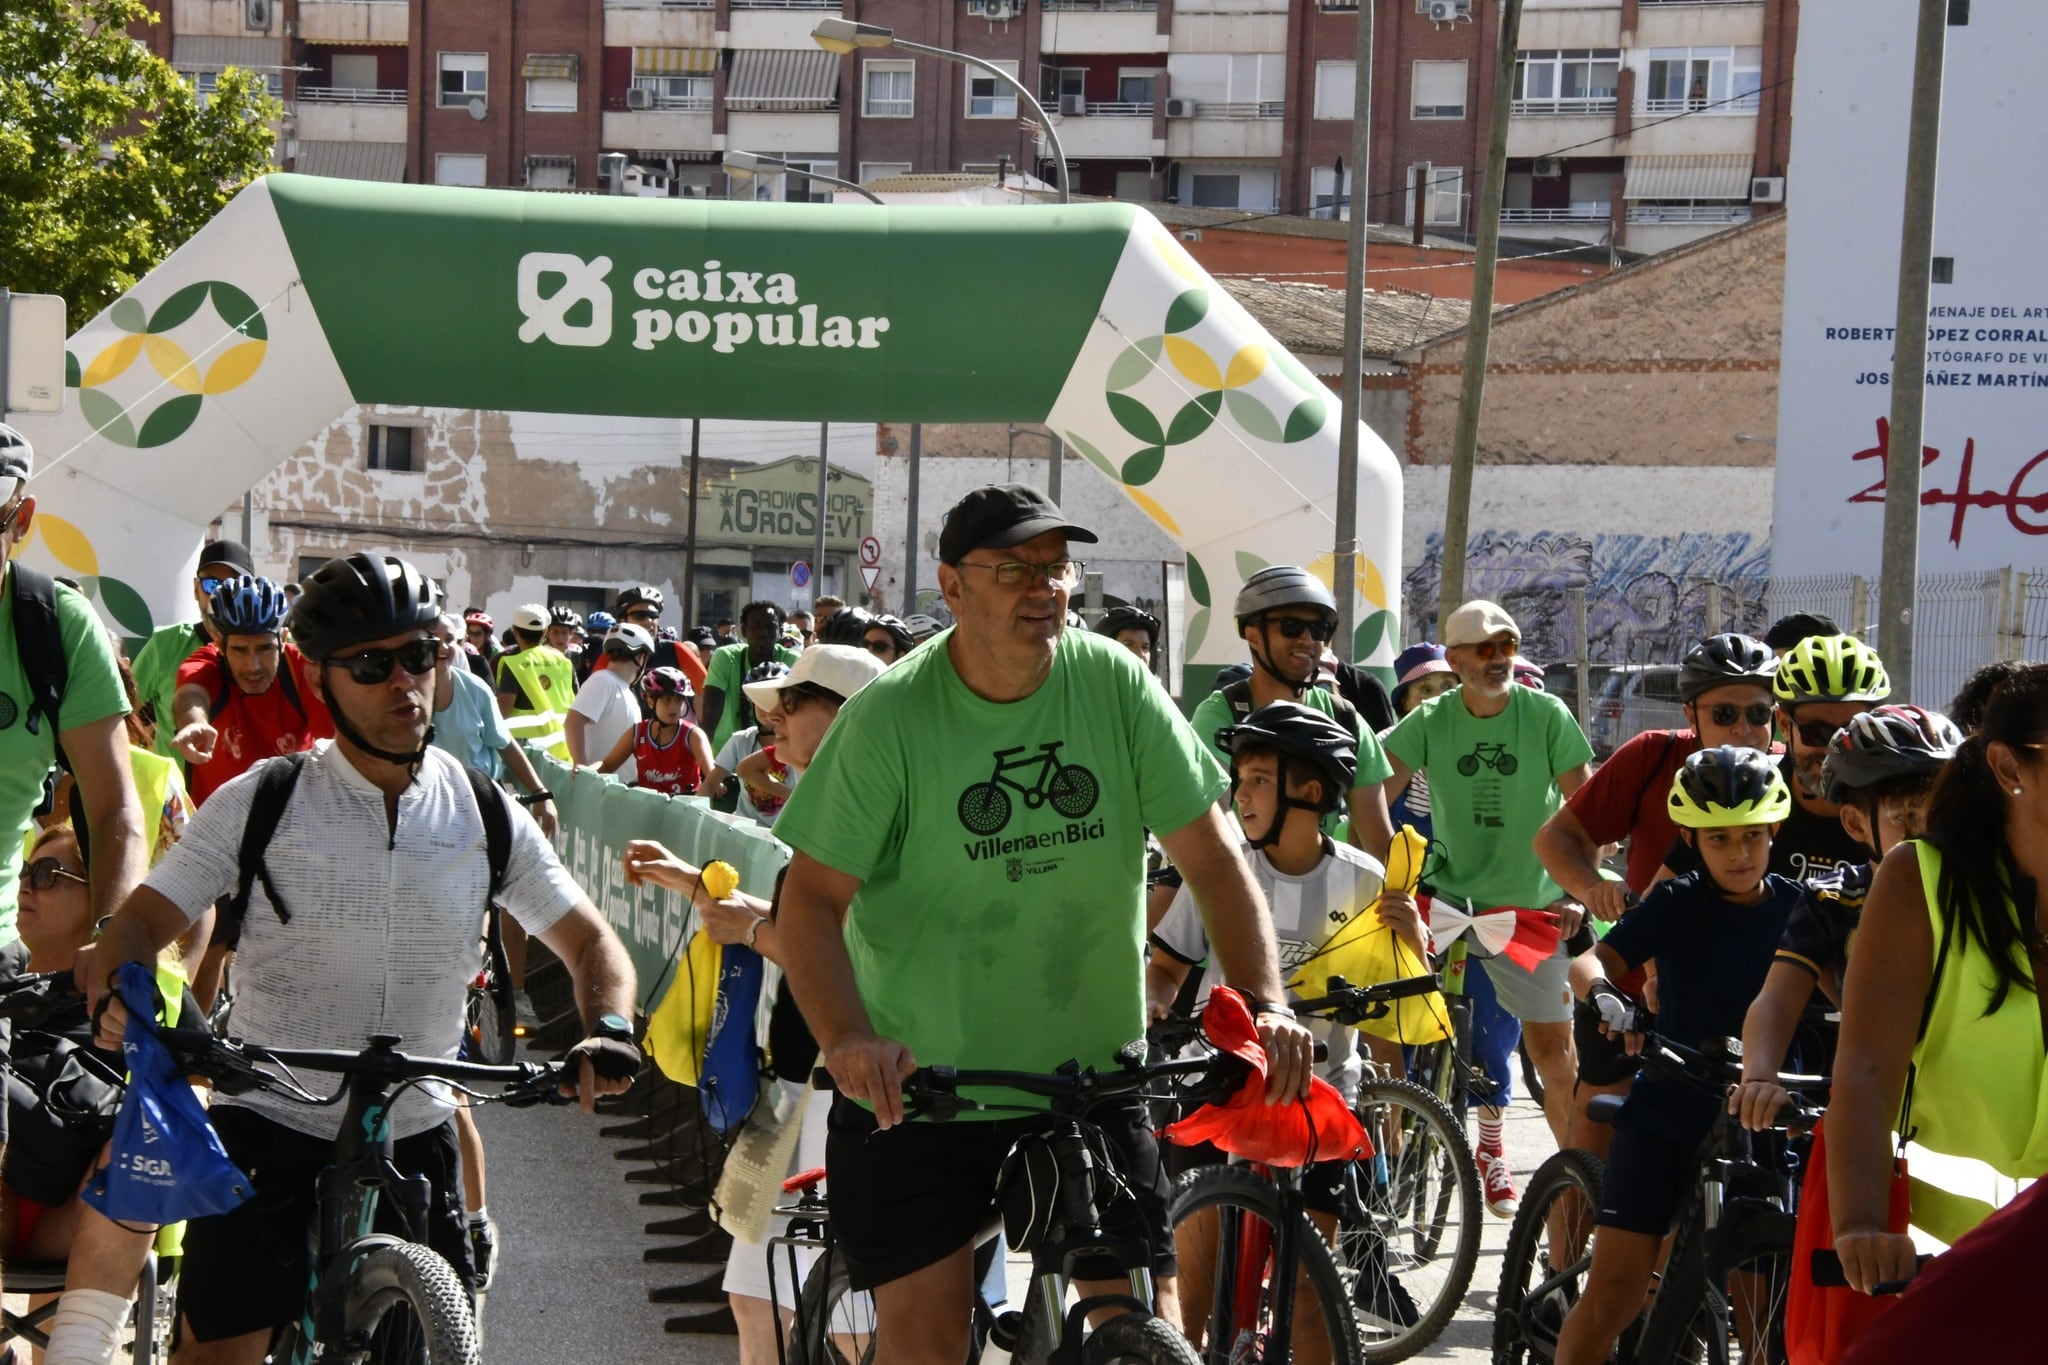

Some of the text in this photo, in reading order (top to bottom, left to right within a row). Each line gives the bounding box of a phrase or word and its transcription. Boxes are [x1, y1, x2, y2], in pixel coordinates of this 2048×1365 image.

[633, 260, 798, 305] caixa
[1929, 307, 1985, 318] MENAJE
[1991, 307, 2017, 318] DEL
[632, 304, 890, 353] popular
[1826, 327, 1896, 340] ROBERT
[1928, 325, 1969, 342] ÓPEZ
[2009, 353, 2027, 363] DE
[1856, 372, 1890, 385] JOS
[1926, 370, 1971, 386] ÁÑEZ
[644, 767, 682, 783] Miami
[964, 818, 1105, 861] VillenaenBici
